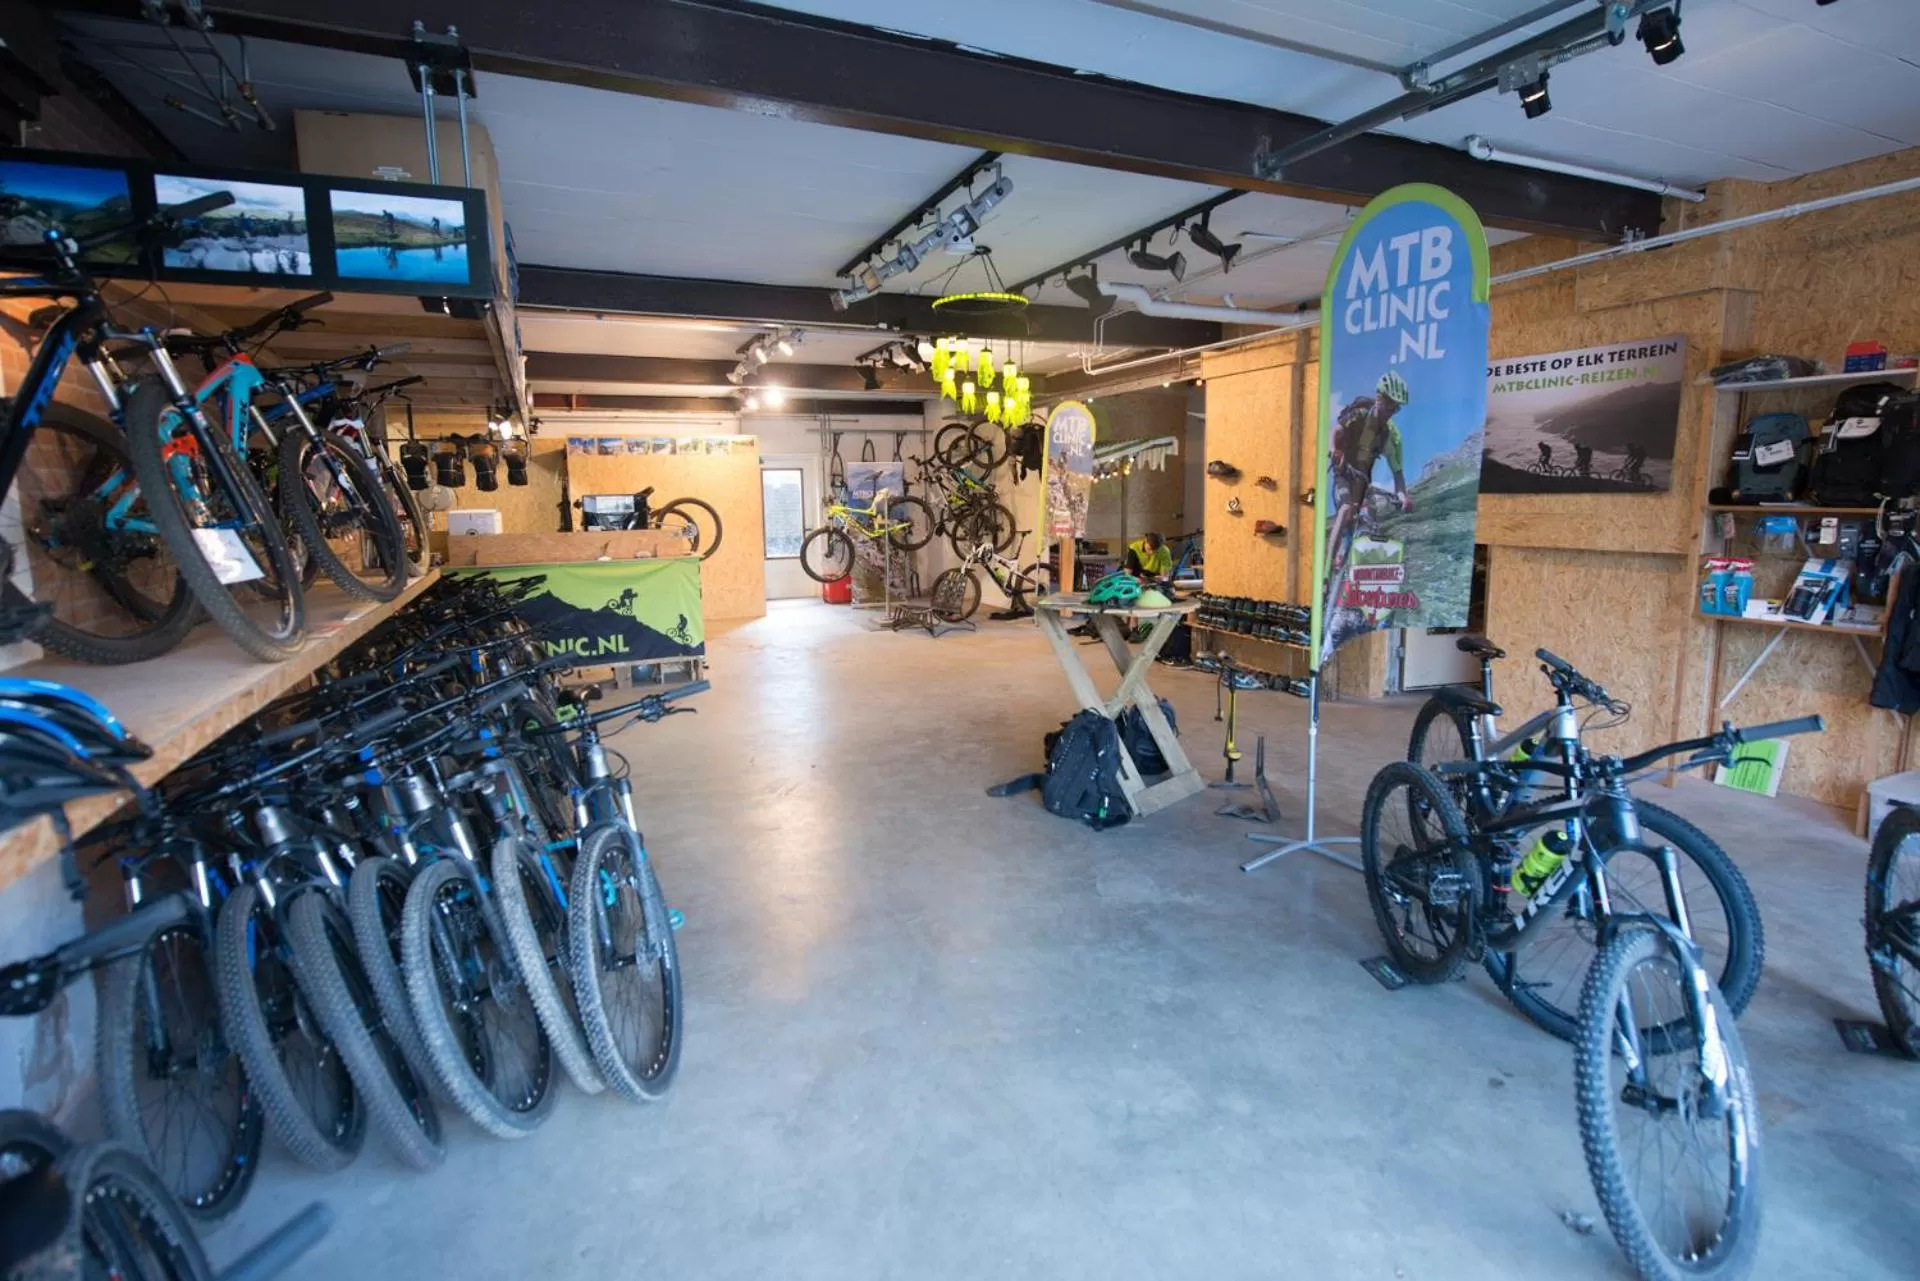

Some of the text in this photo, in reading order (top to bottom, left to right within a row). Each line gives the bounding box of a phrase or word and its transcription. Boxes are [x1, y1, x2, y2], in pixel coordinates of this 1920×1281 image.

[1345, 225, 1453, 299] MTB
[1344, 281, 1451, 335] CLINIC
[1390, 322, 1446, 364] .NL
[1506, 361, 1547, 376] BESTE
[1551, 357, 1573, 370] OP
[1577, 353, 1604, 367] ELK
[1608, 342, 1678, 363] TERREIN
